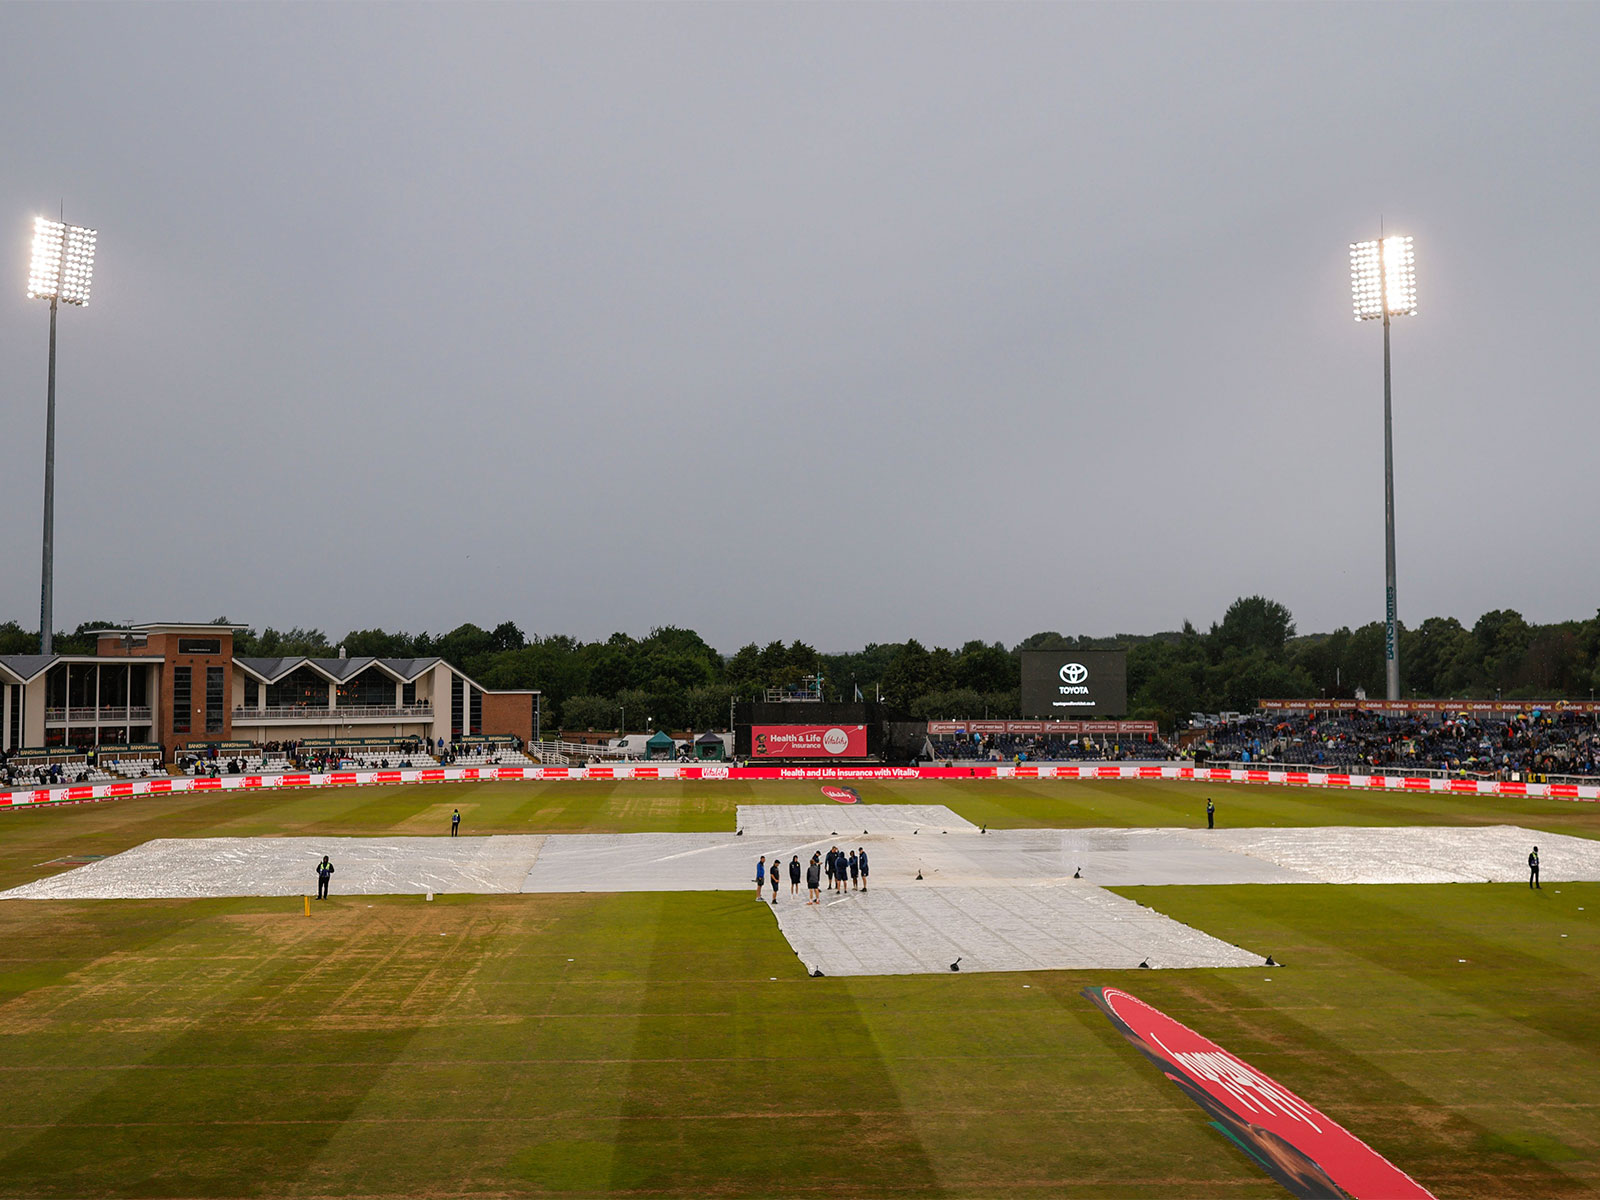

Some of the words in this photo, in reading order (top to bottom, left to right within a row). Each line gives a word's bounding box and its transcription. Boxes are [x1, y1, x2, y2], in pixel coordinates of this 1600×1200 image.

[1059, 686, 1089, 694] TOYOTA
[770, 734, 797, 742] Health
[806, 734, 821, 742] Life
[824, 735, 847, 745] Vitality
[780, 768, 805, 776] Health
[806, 768, 821, 776] and
[822, 768, 836, 776] Life
[837, 768, 873, 776] insurance
[874, 768, 891, 776] with
[892, 768, 919, 778] Vitality
